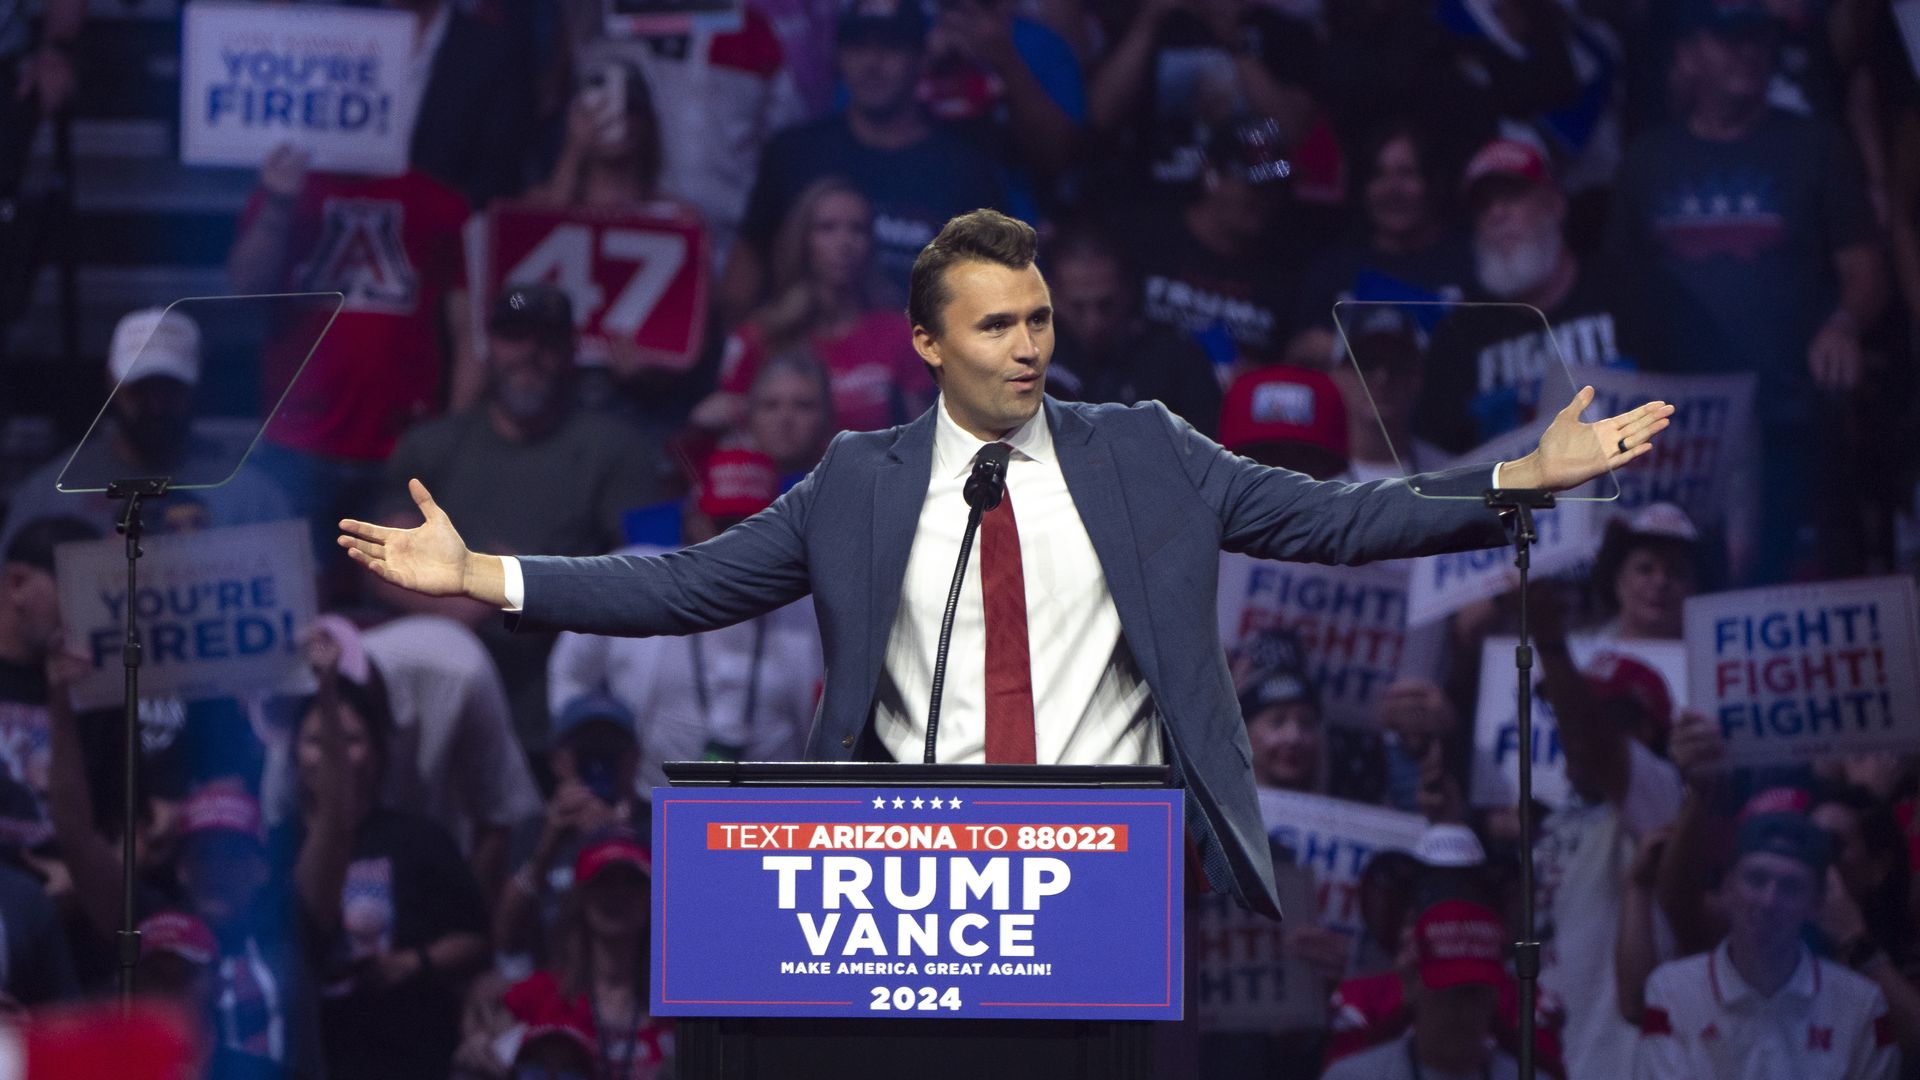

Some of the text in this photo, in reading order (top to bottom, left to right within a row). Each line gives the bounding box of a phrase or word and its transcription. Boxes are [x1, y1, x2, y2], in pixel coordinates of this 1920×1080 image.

[222, 51, 376, 86] YOU'RE
[207, 86, 392, 137] FIRED!
[101, 576, 276, 621] YOU'RE
[90, 611, 296, 670] FRED!
[1715, 602, 1880, 655] FIGHT!
[1717, 649, 1887, 698] FIGHT!
[1719, 691, 1893, 741] FIGHT!
[720, 825, 1116, 850] TEXT ARIZONA TO 88022
[762, 855, 1072, 911] TRUMP
[796, 912, 1035, 957] VANCE
[780, 961, 1052, 976] MAKE AMERICA GREAT AGAIN!
[869, 986, 962, 1011] 2024
